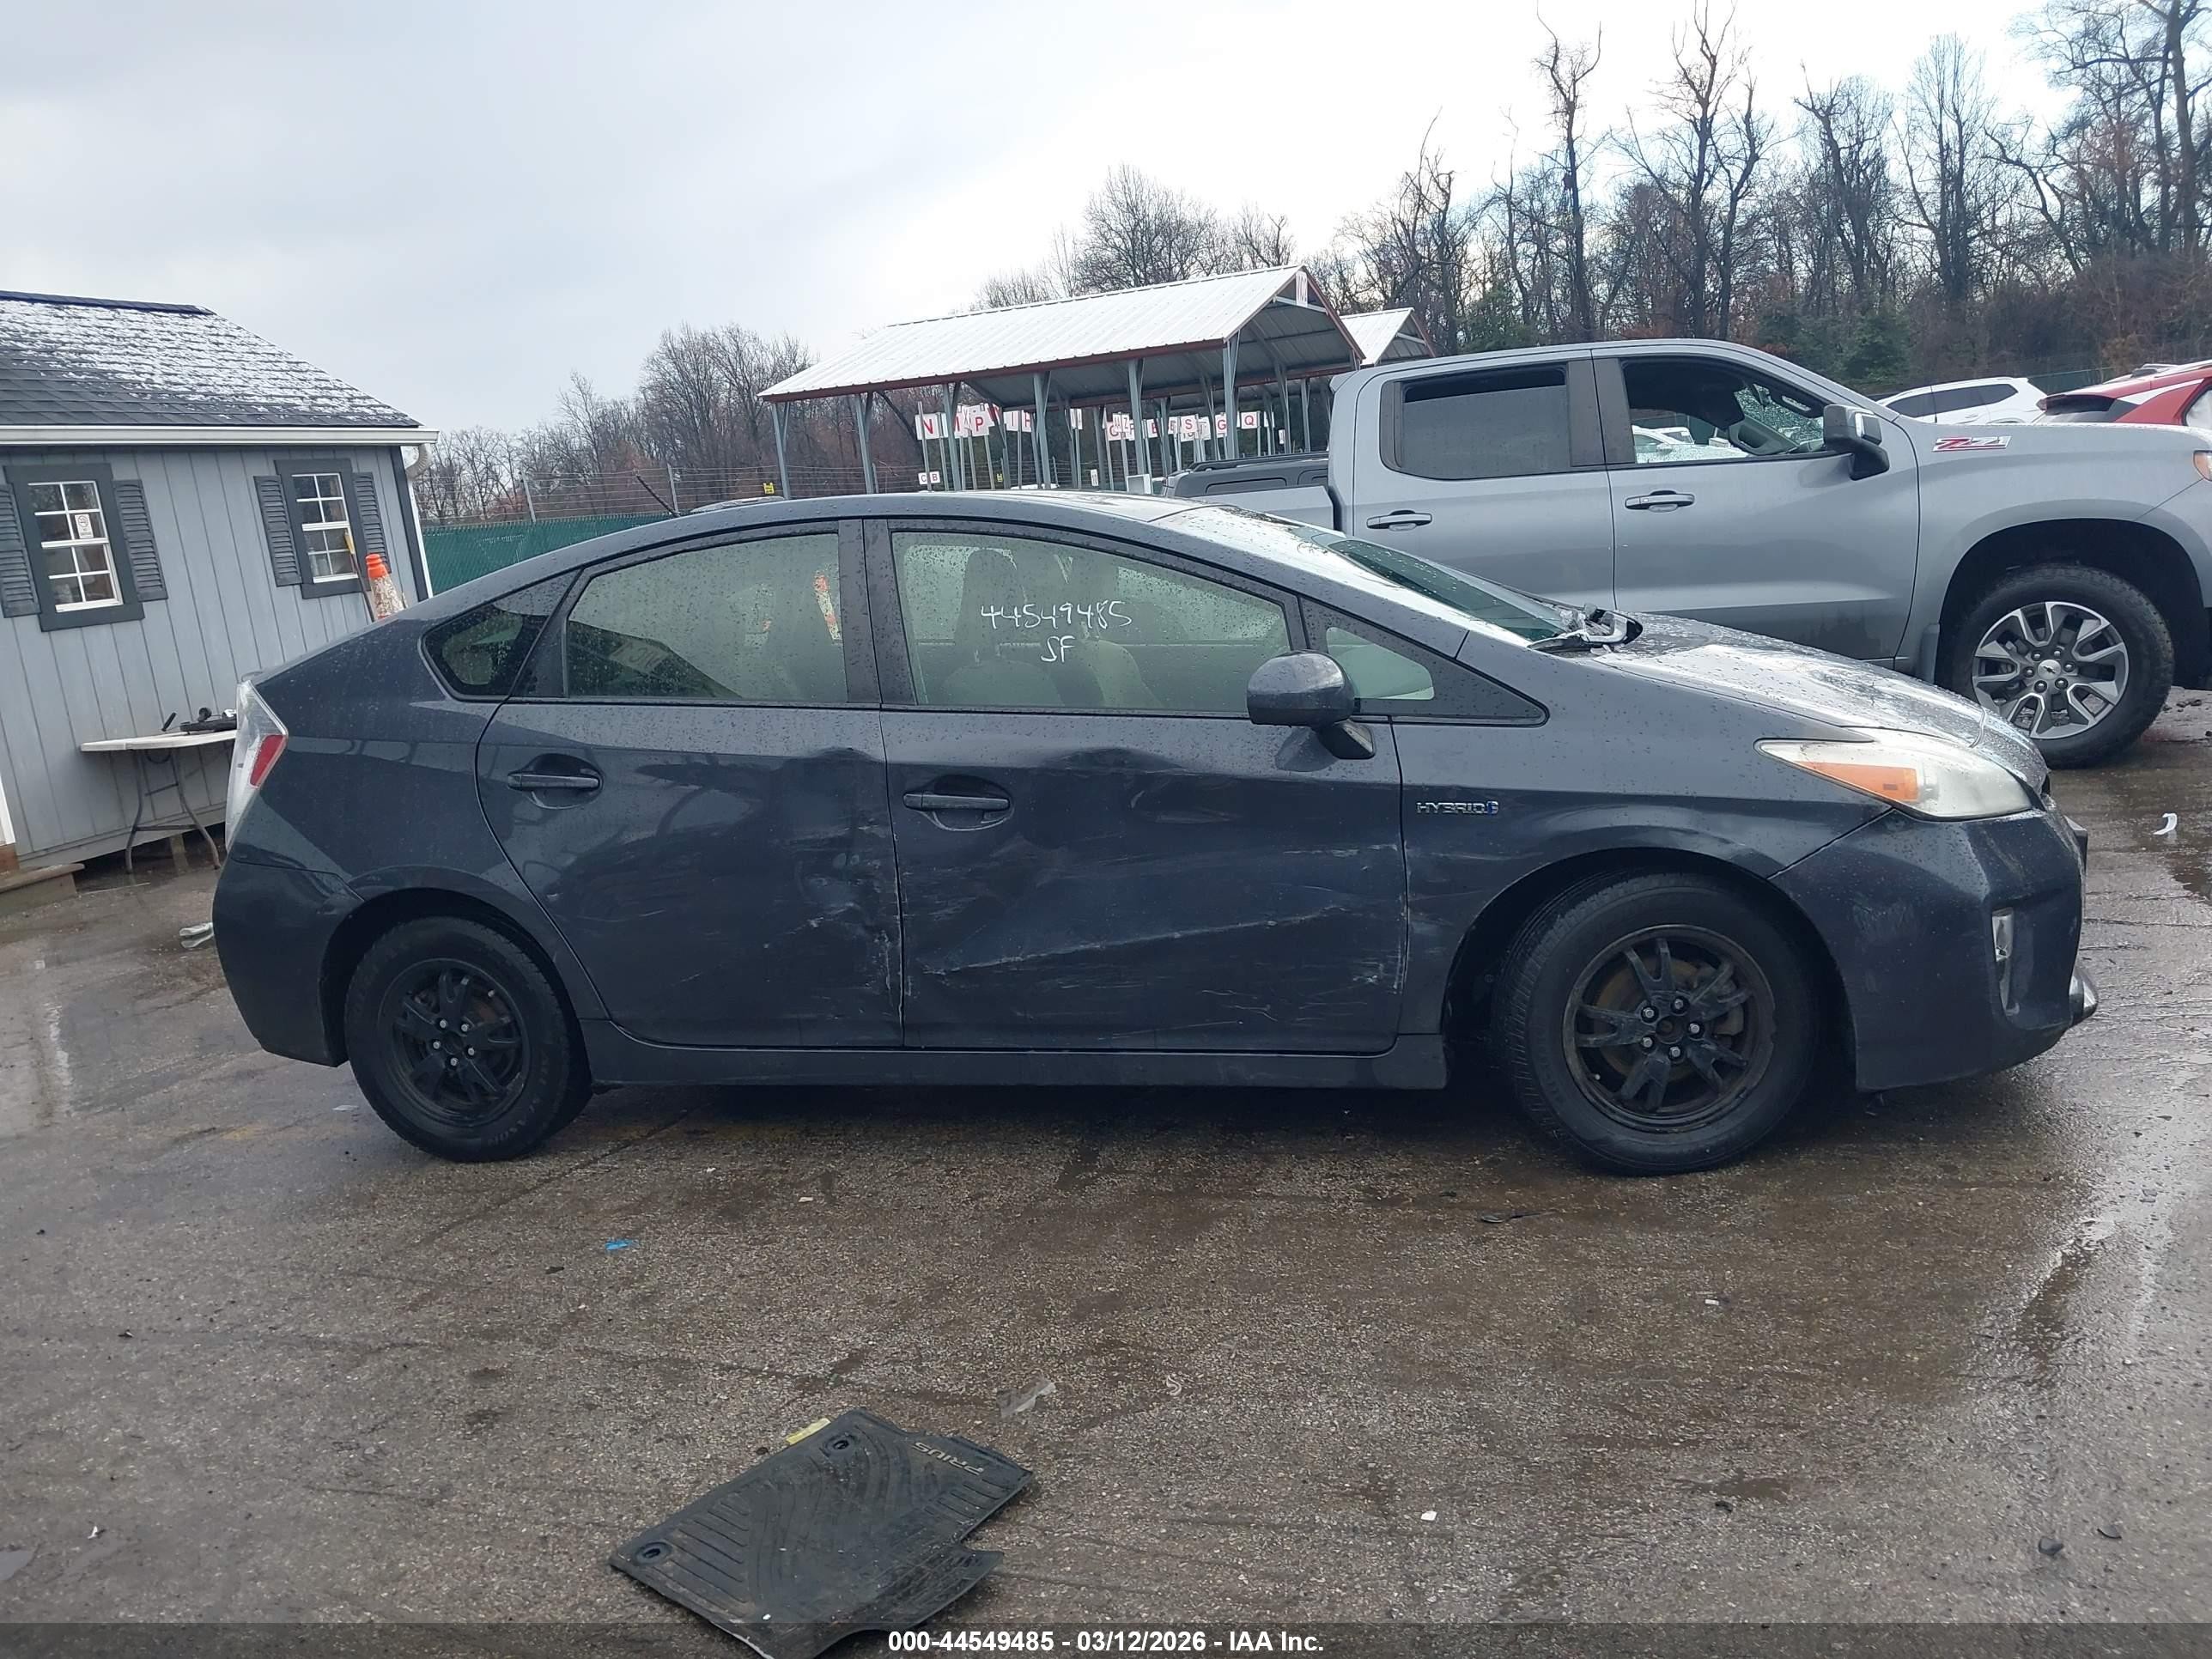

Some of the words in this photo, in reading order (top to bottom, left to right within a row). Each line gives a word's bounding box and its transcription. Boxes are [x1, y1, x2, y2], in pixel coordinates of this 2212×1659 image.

[975, 416, 984, 432] P
[1185, 418, 1193, 430] S
[1217, 419, 1226, 430] G
[1244, 416, 1254, 426] Q
[981, 599, 1133, 629] 44549485
[1416, 802, 1486, 814] HYBRID
[911, 1442, 984, 1475] PRIUS
